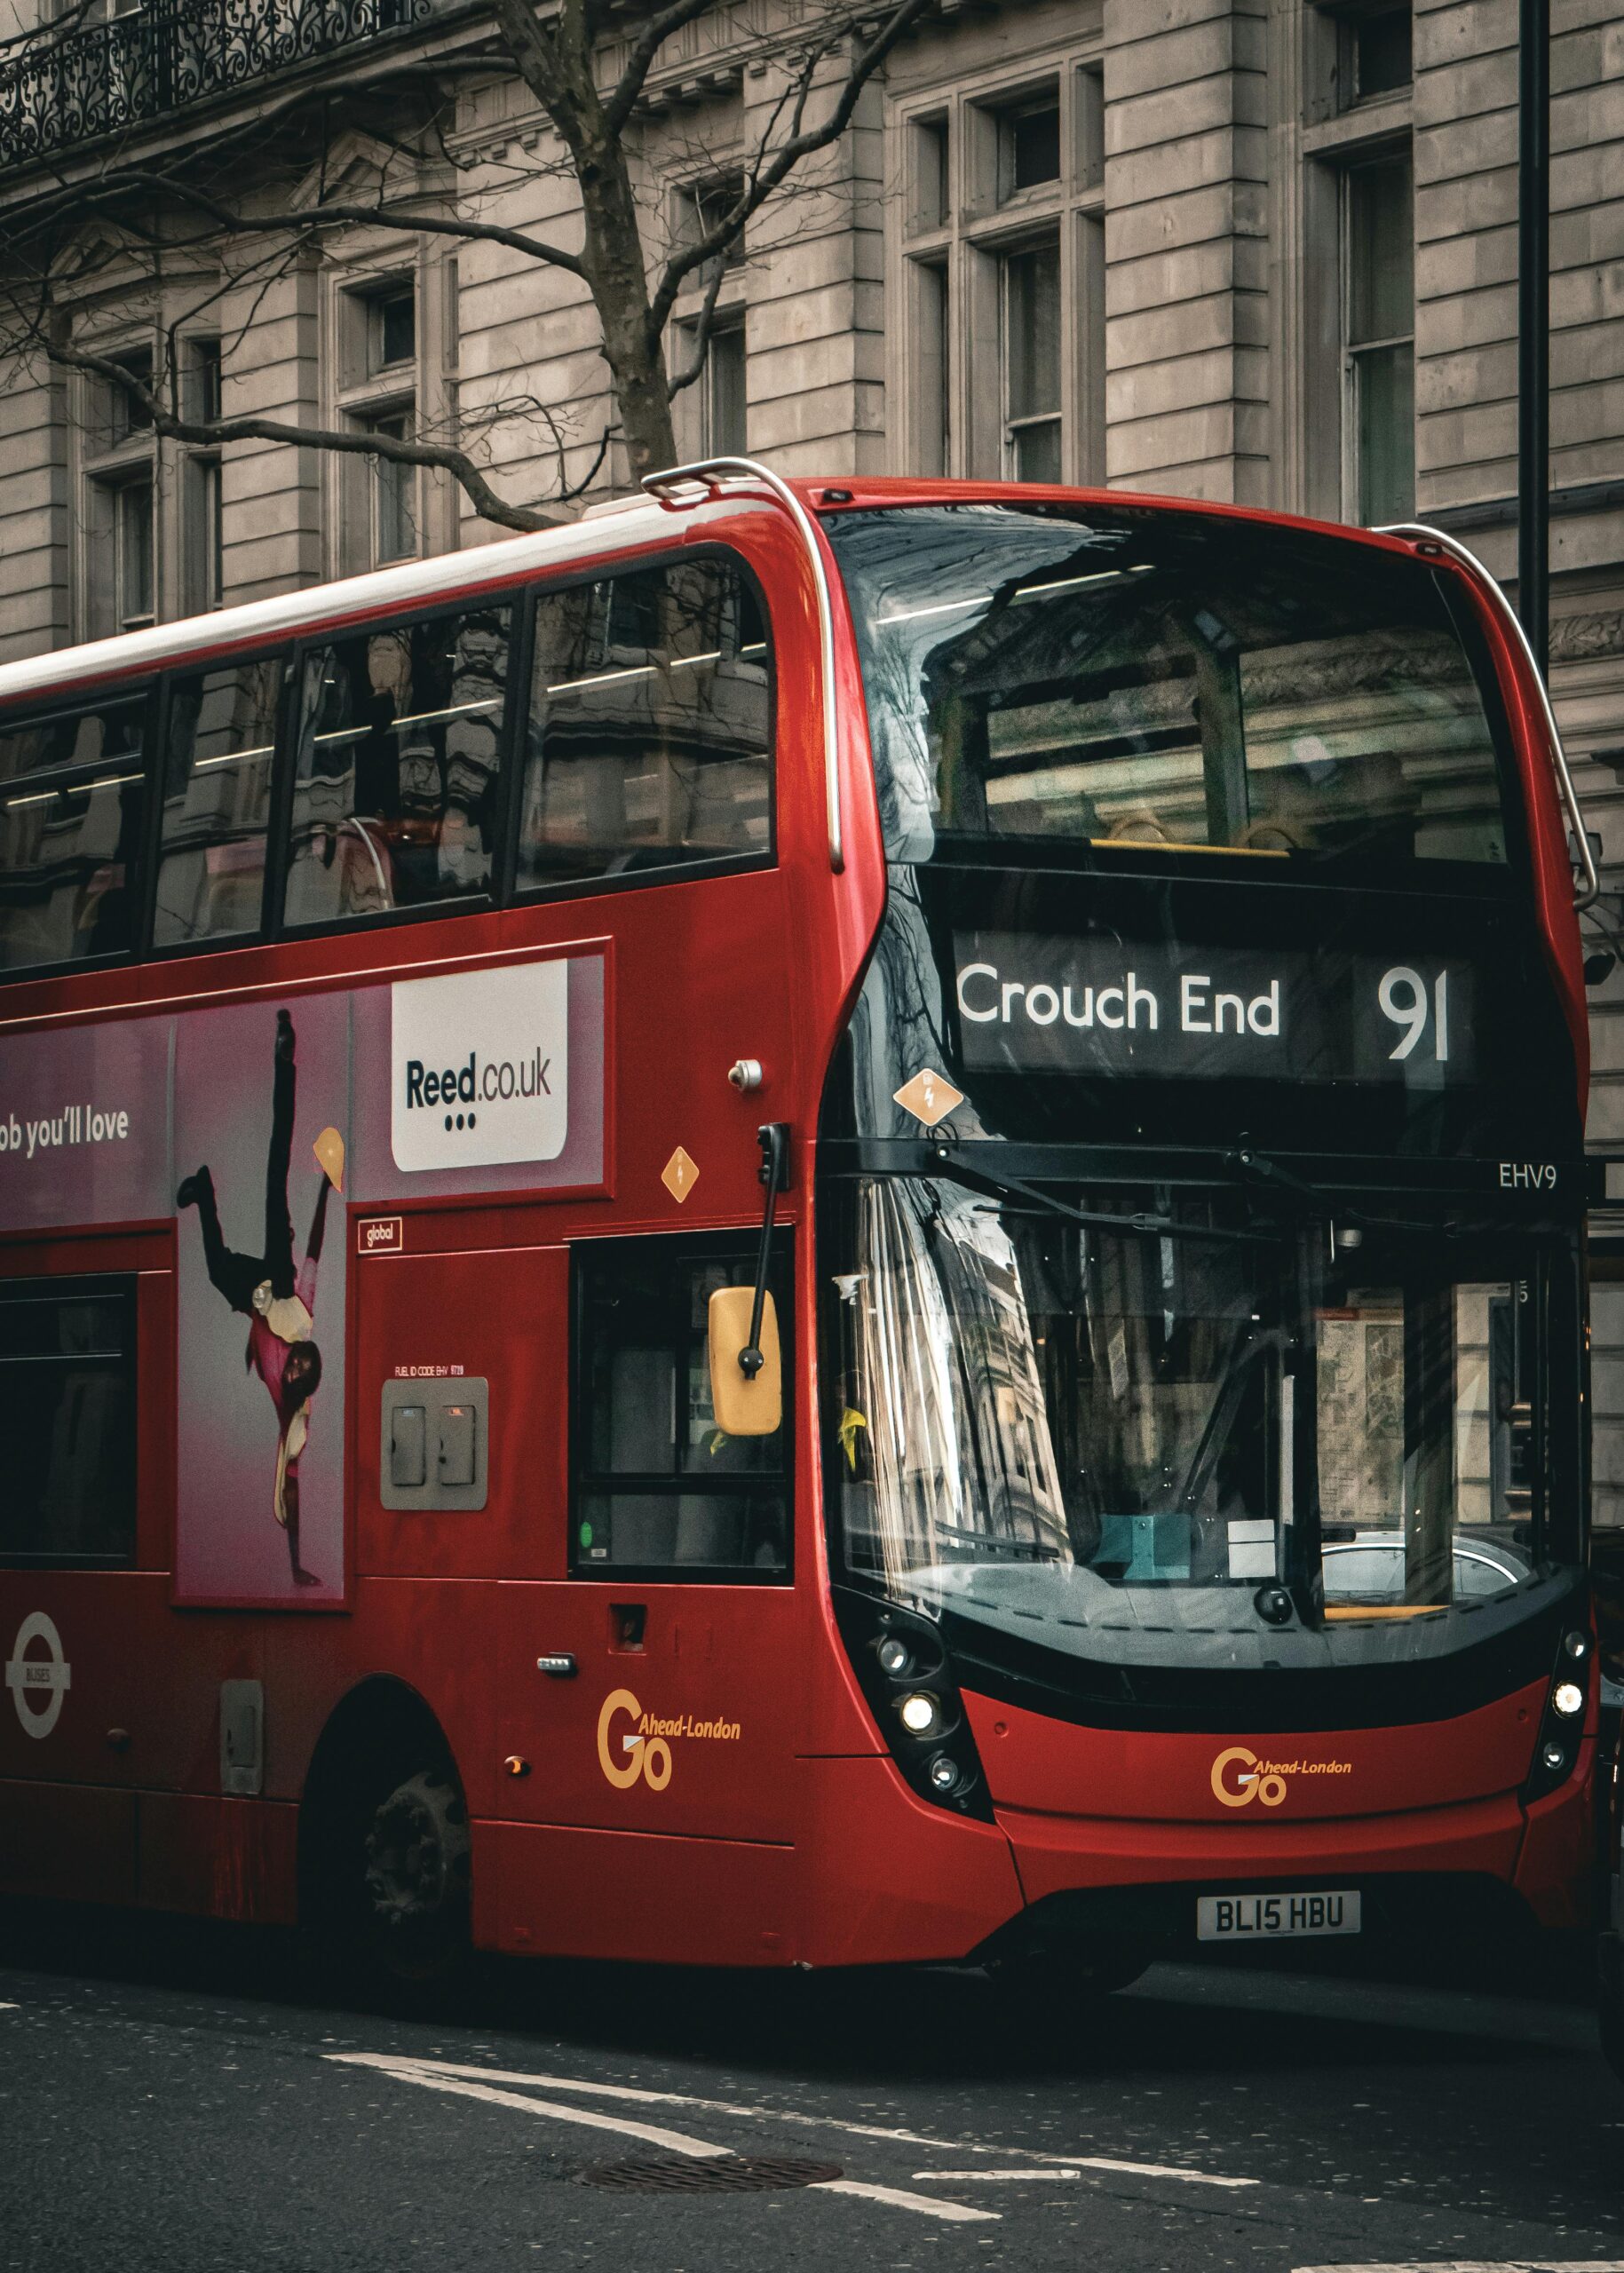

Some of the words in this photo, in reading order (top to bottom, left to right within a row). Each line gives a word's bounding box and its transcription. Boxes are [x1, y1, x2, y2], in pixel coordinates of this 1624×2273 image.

[956, 963, 1158, 1030] Crouch
[1181, 975, 1279, 1036] End
[1378, 966, 1448, 1061] 91
[407, 1046, 551, 1109] Reed.co.uk
[26, 1105, 81, 1159] you'll
[86, 1104, 129, 1142] love
[1499, 1163, 1557, 1189] EHV9
[367, 1223, 393, 1247] global
[26, 1667, 51, 1683] BUSES
[597, 1688, 672, 1792] Go
[638, 1713, 741, 1740] Ahead-London
[1210, 1746, 1287, 1808] Go
[1253, 1759, 1352, 1775] Ahead-London
[1216, 1898, 1281, 1932] BL15
[1289, 1896, 1343, 1928] HBU
